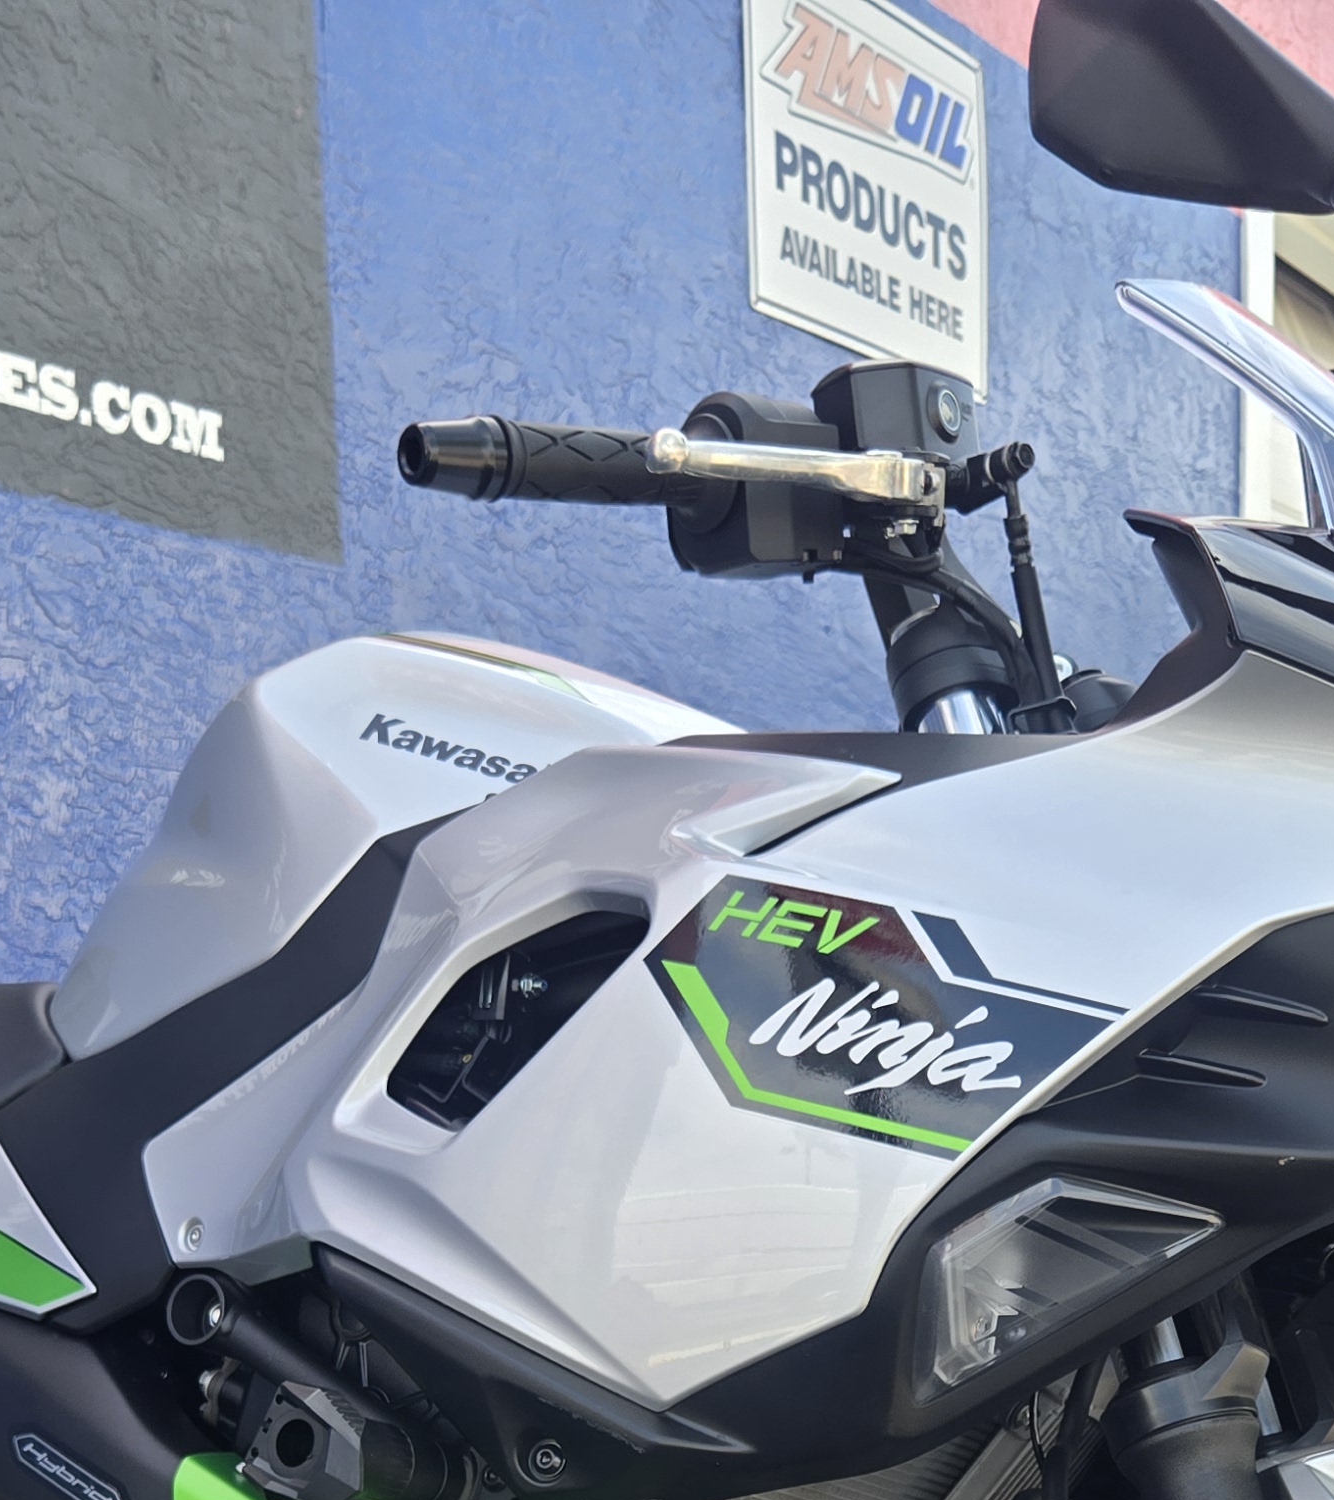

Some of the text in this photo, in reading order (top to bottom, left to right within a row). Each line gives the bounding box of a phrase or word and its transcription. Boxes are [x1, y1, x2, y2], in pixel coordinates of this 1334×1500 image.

[774, 3, 970, 170] AMSOIL
[774, 131, 968, 281] PRODUCTS
[779, 226, 964, 342] AVAILABLE HERE
[359, 713, 553, 784] Kawasa
[708, 891, 880, 954] HEV
[749, 978, 1021, 1095] Ninja
